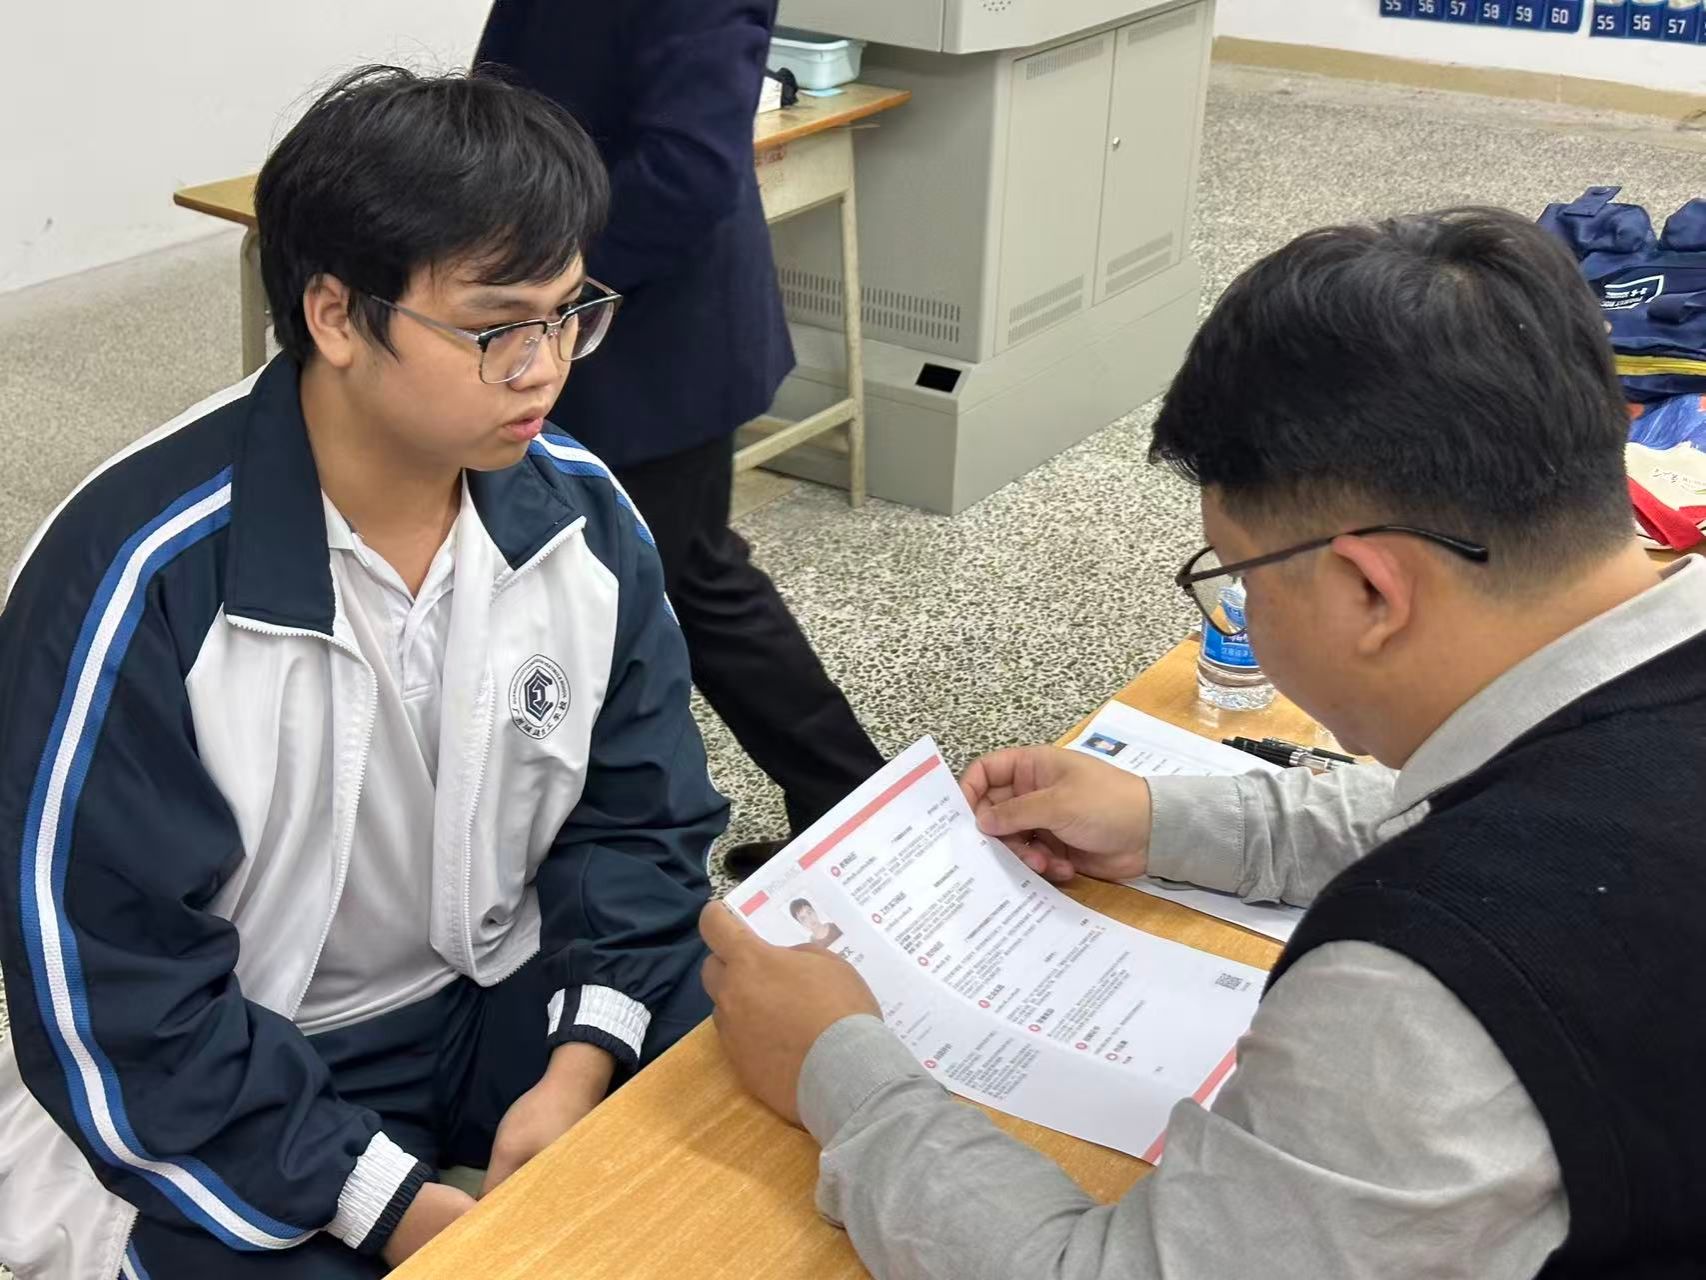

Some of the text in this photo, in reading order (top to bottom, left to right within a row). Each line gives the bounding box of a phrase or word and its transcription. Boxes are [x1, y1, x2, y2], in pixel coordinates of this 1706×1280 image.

[1385, 0, 1569, 24] 55 56 57 58 59 60
[1597, 15, 1615, 30] 55
[1633, 15, 1651, 31] 56
[1668, 19, 1687, 34] 57
